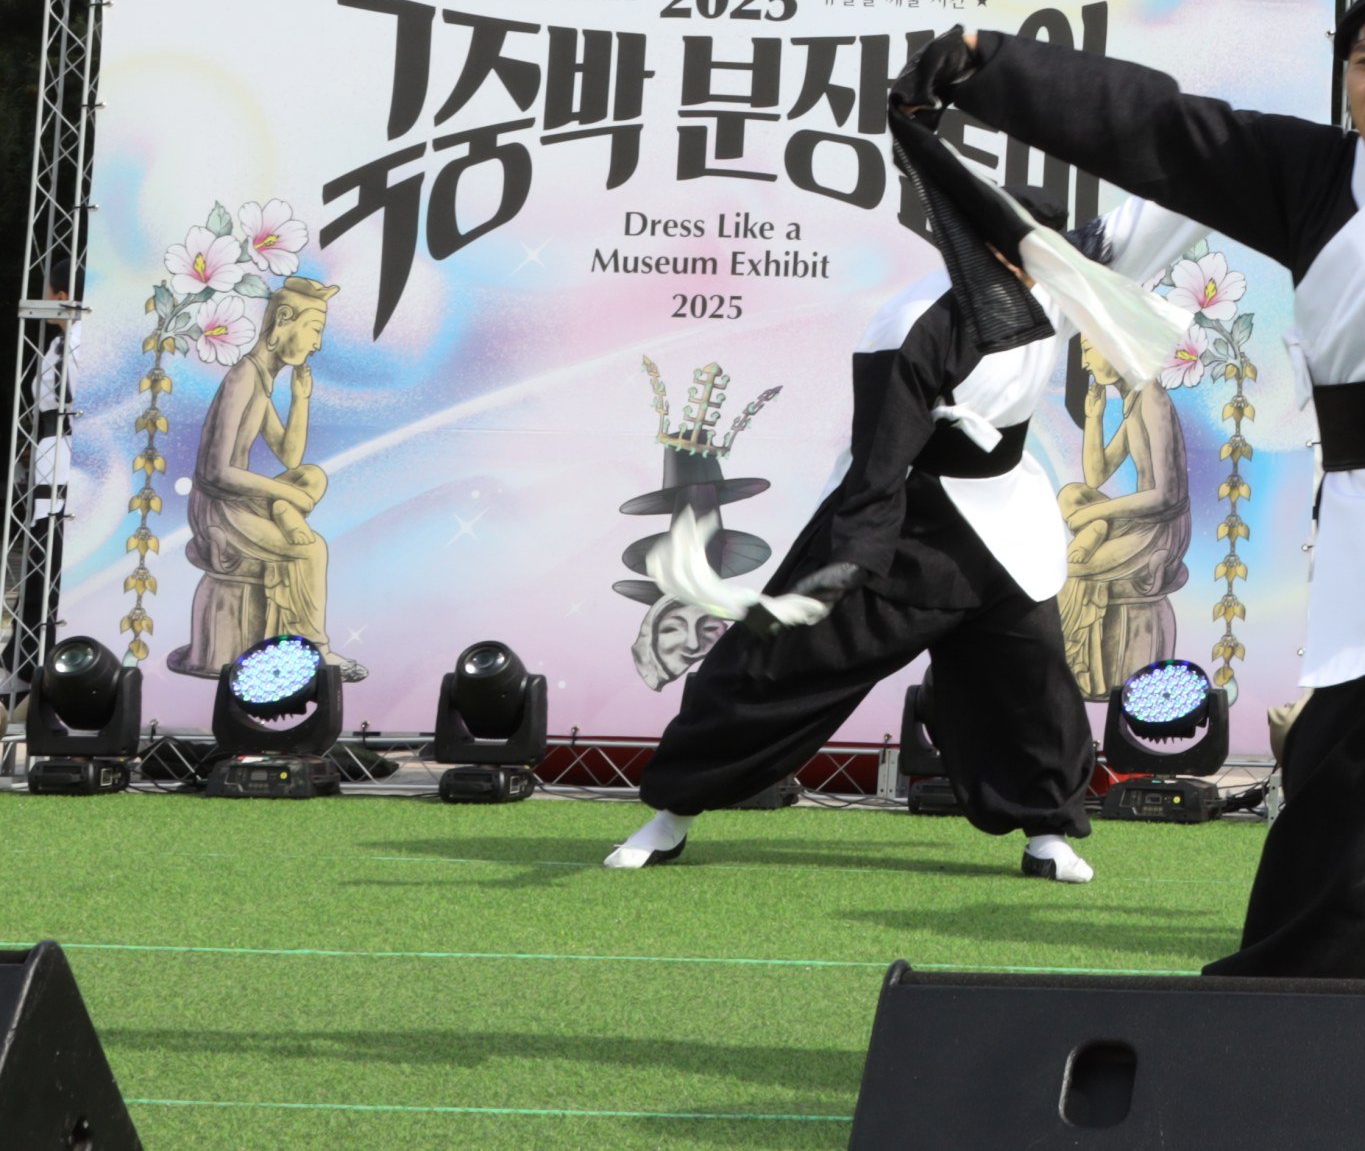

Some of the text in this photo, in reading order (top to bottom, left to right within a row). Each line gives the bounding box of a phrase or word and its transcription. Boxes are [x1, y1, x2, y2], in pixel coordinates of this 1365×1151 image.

[623, 211, 802, 241] Dress Like a
[591, 248, 831, 279] Museum Exhibit
[671, 294, 744, 320] 2025
